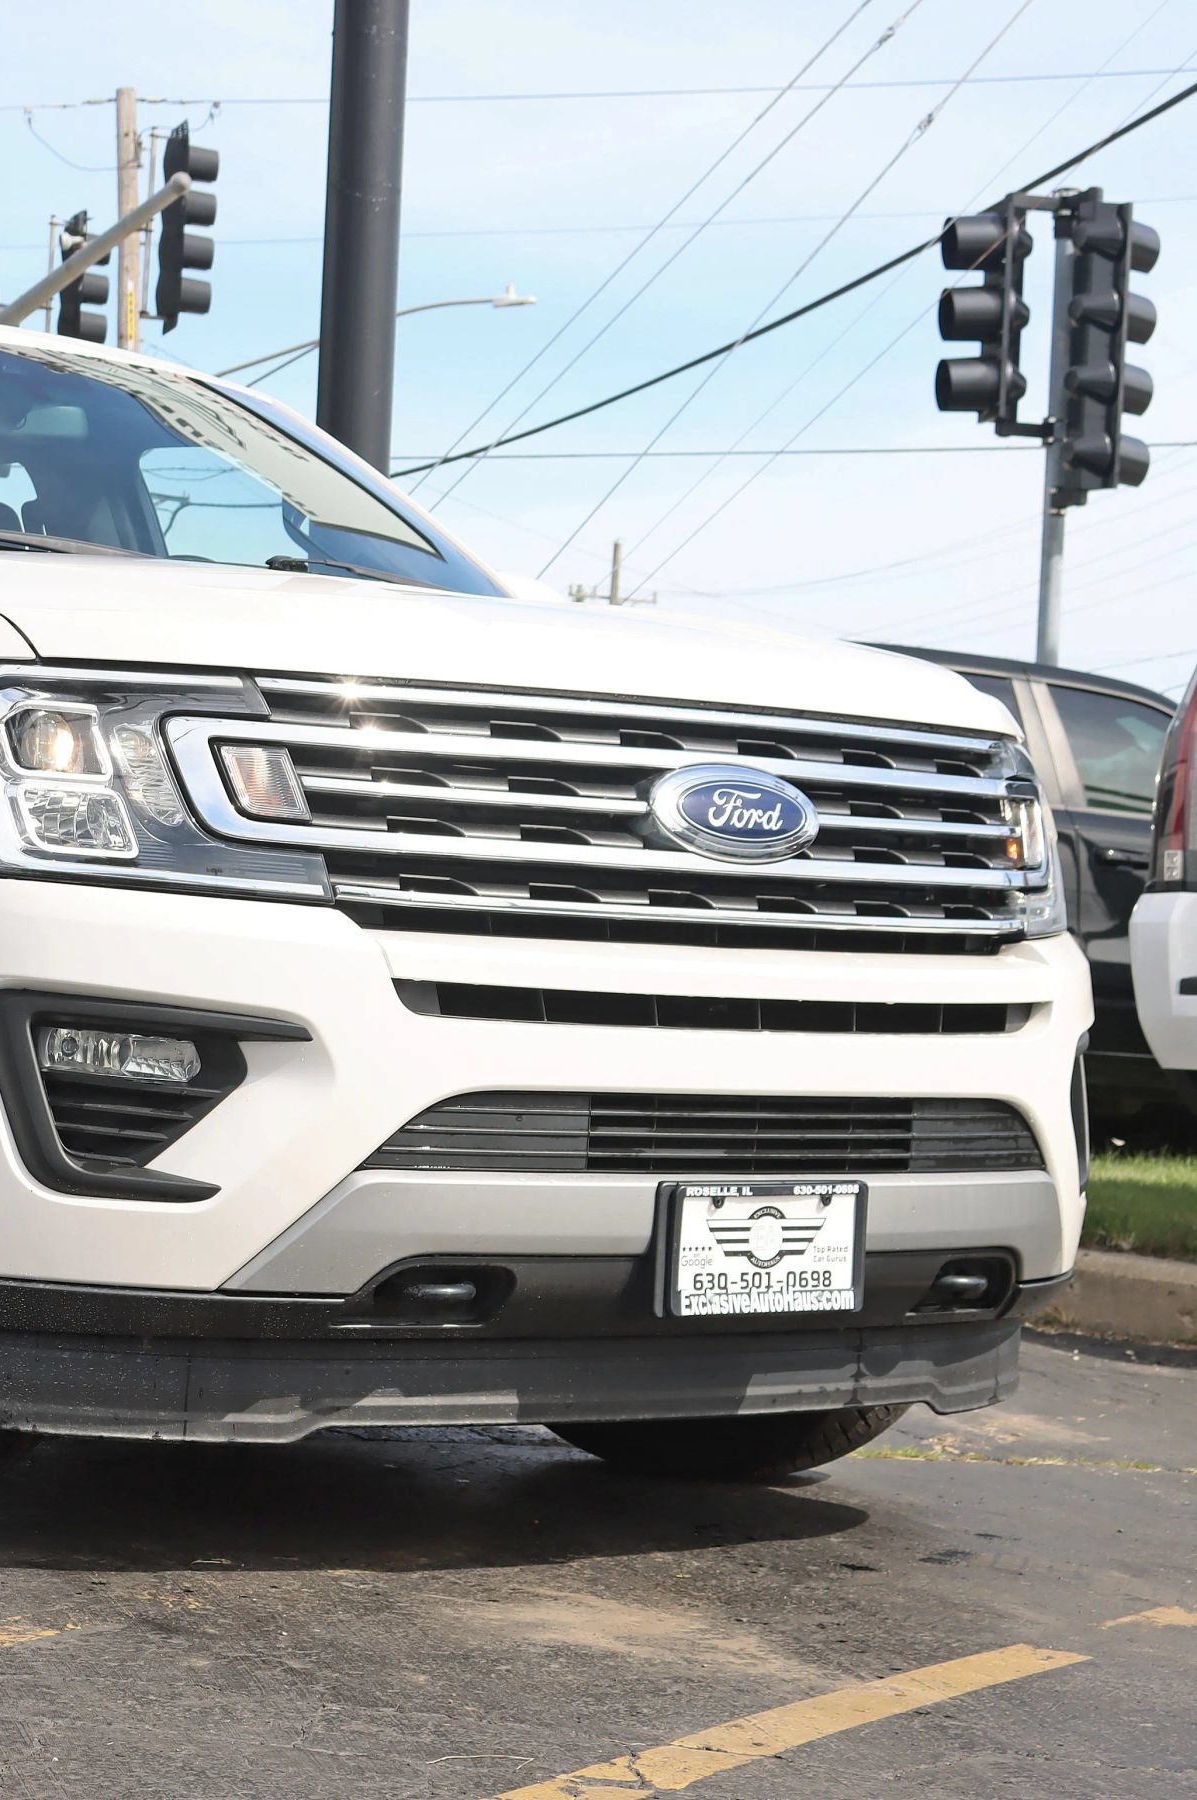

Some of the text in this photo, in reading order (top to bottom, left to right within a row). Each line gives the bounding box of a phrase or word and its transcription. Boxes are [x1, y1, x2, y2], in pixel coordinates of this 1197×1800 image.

[708, 788, 784, 830] Ford
[686, 1186, 753, 1197] ROSELLE, IL
[793, 1184, 860, 1195] 630-501-0698
[753, 1208, 782, 1219] EXCLUSIVE
[681, 1255, 713, 1269] Google
[693, 1271, 832, 1290] 630-501-0698
[680, 1288, 855, 1316] ExclusiveAutoHaus.com
